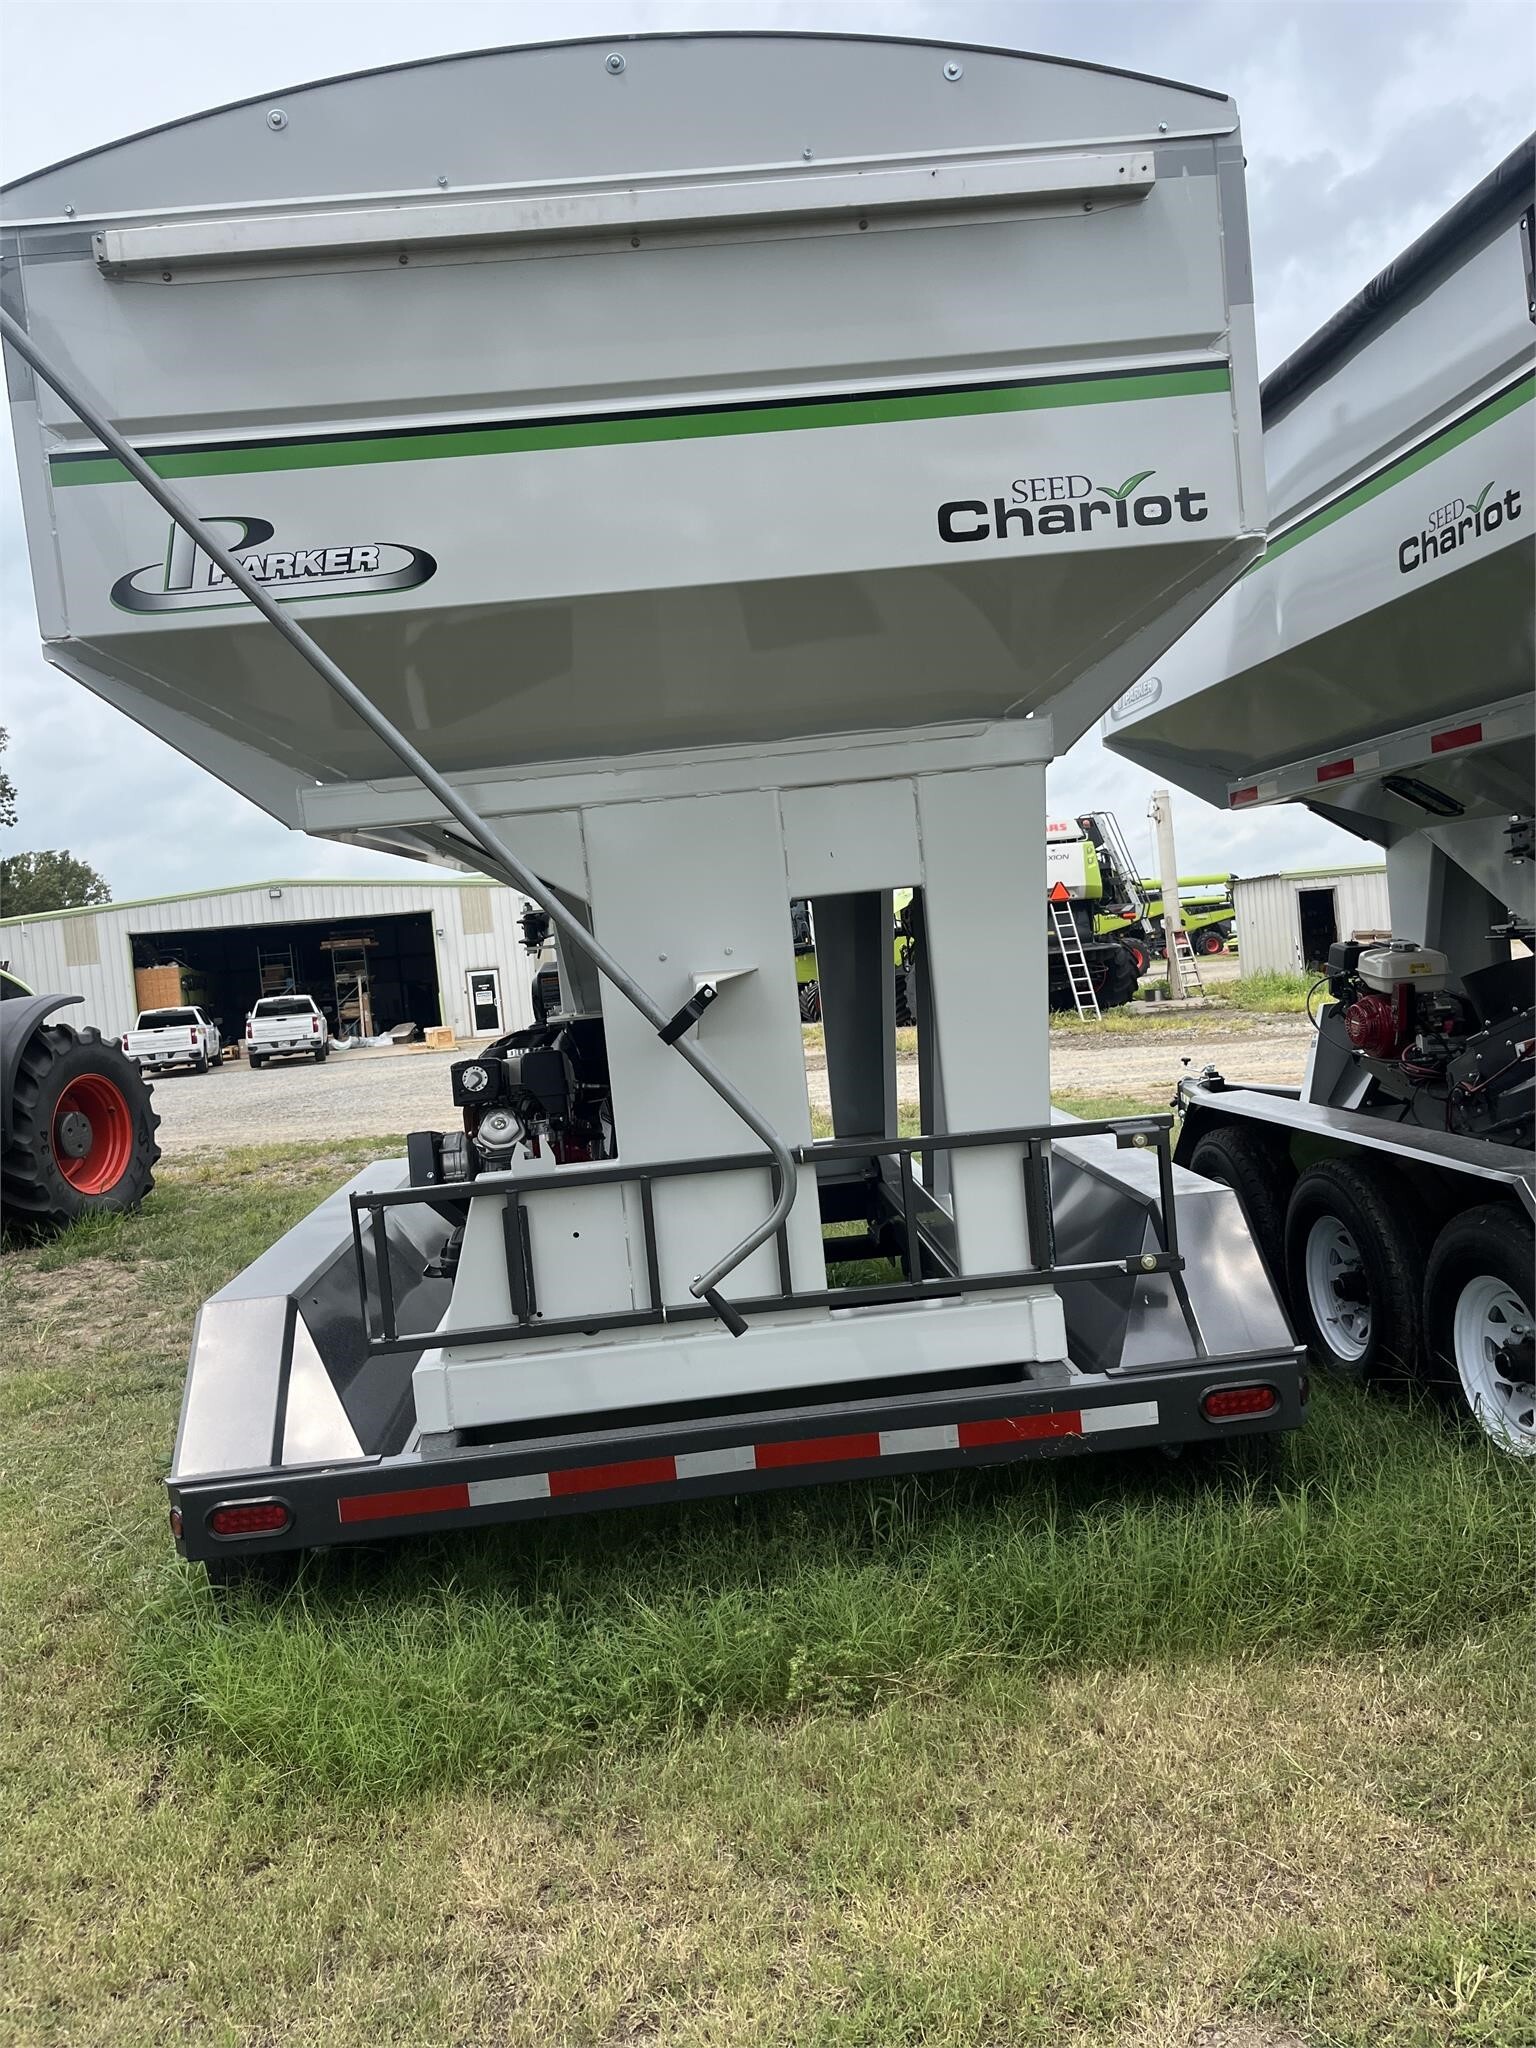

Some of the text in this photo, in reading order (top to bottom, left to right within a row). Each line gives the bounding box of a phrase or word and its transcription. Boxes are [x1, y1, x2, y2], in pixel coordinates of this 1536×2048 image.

[1011, 475, 1092, 504] SEED
[937, 486, 1209, 544] Chariot
[1398, 488, 1522, 574] Chariot
[1427, 498, 1465, 533] SEED
